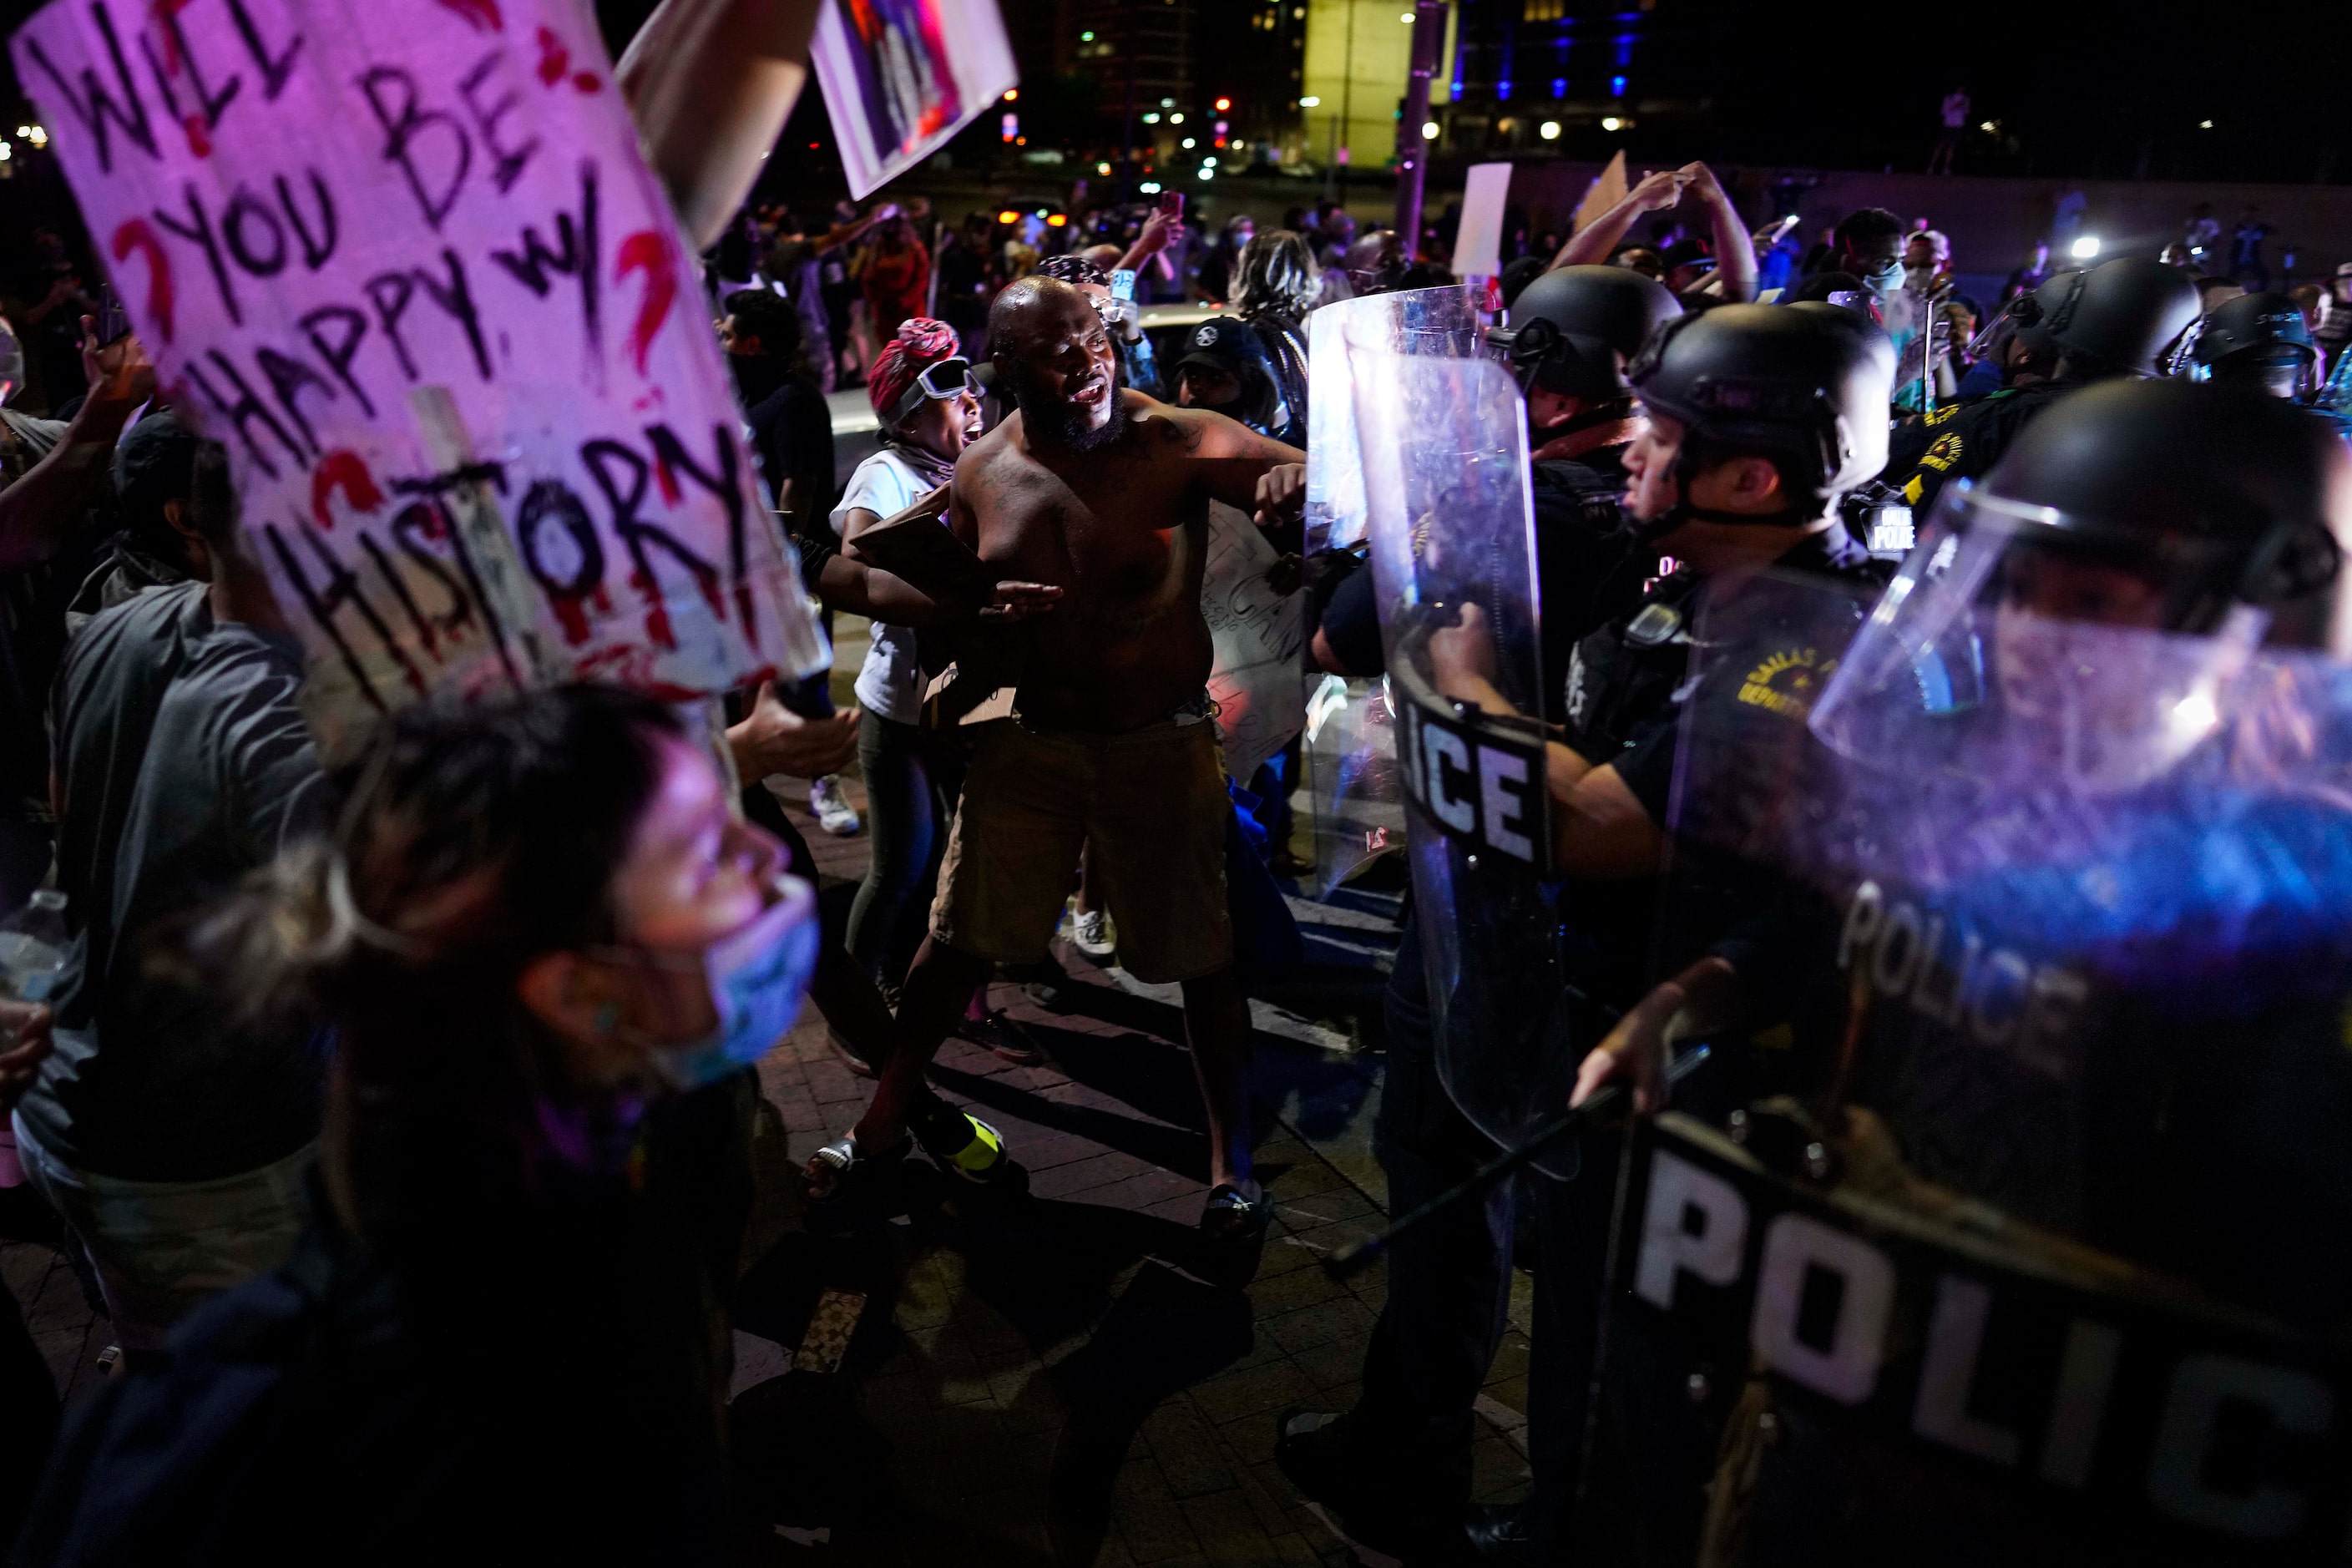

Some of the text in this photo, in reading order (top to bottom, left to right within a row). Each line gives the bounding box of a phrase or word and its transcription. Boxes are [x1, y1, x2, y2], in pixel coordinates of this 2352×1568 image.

[27, 0, 539, 230] WILL BE
[154, 169, 336, 327] YOU
[185, 250, 491, 481] HAPPY
[266, 427, 748, 711] HISTORY
[1874, 526, 1915, 549] POLICE
[1404, 701, 1536, 864] ICE
[1837, 882, 2089, 1079] POLICE
[1631, 1144, 2350, 1548] POLIC
